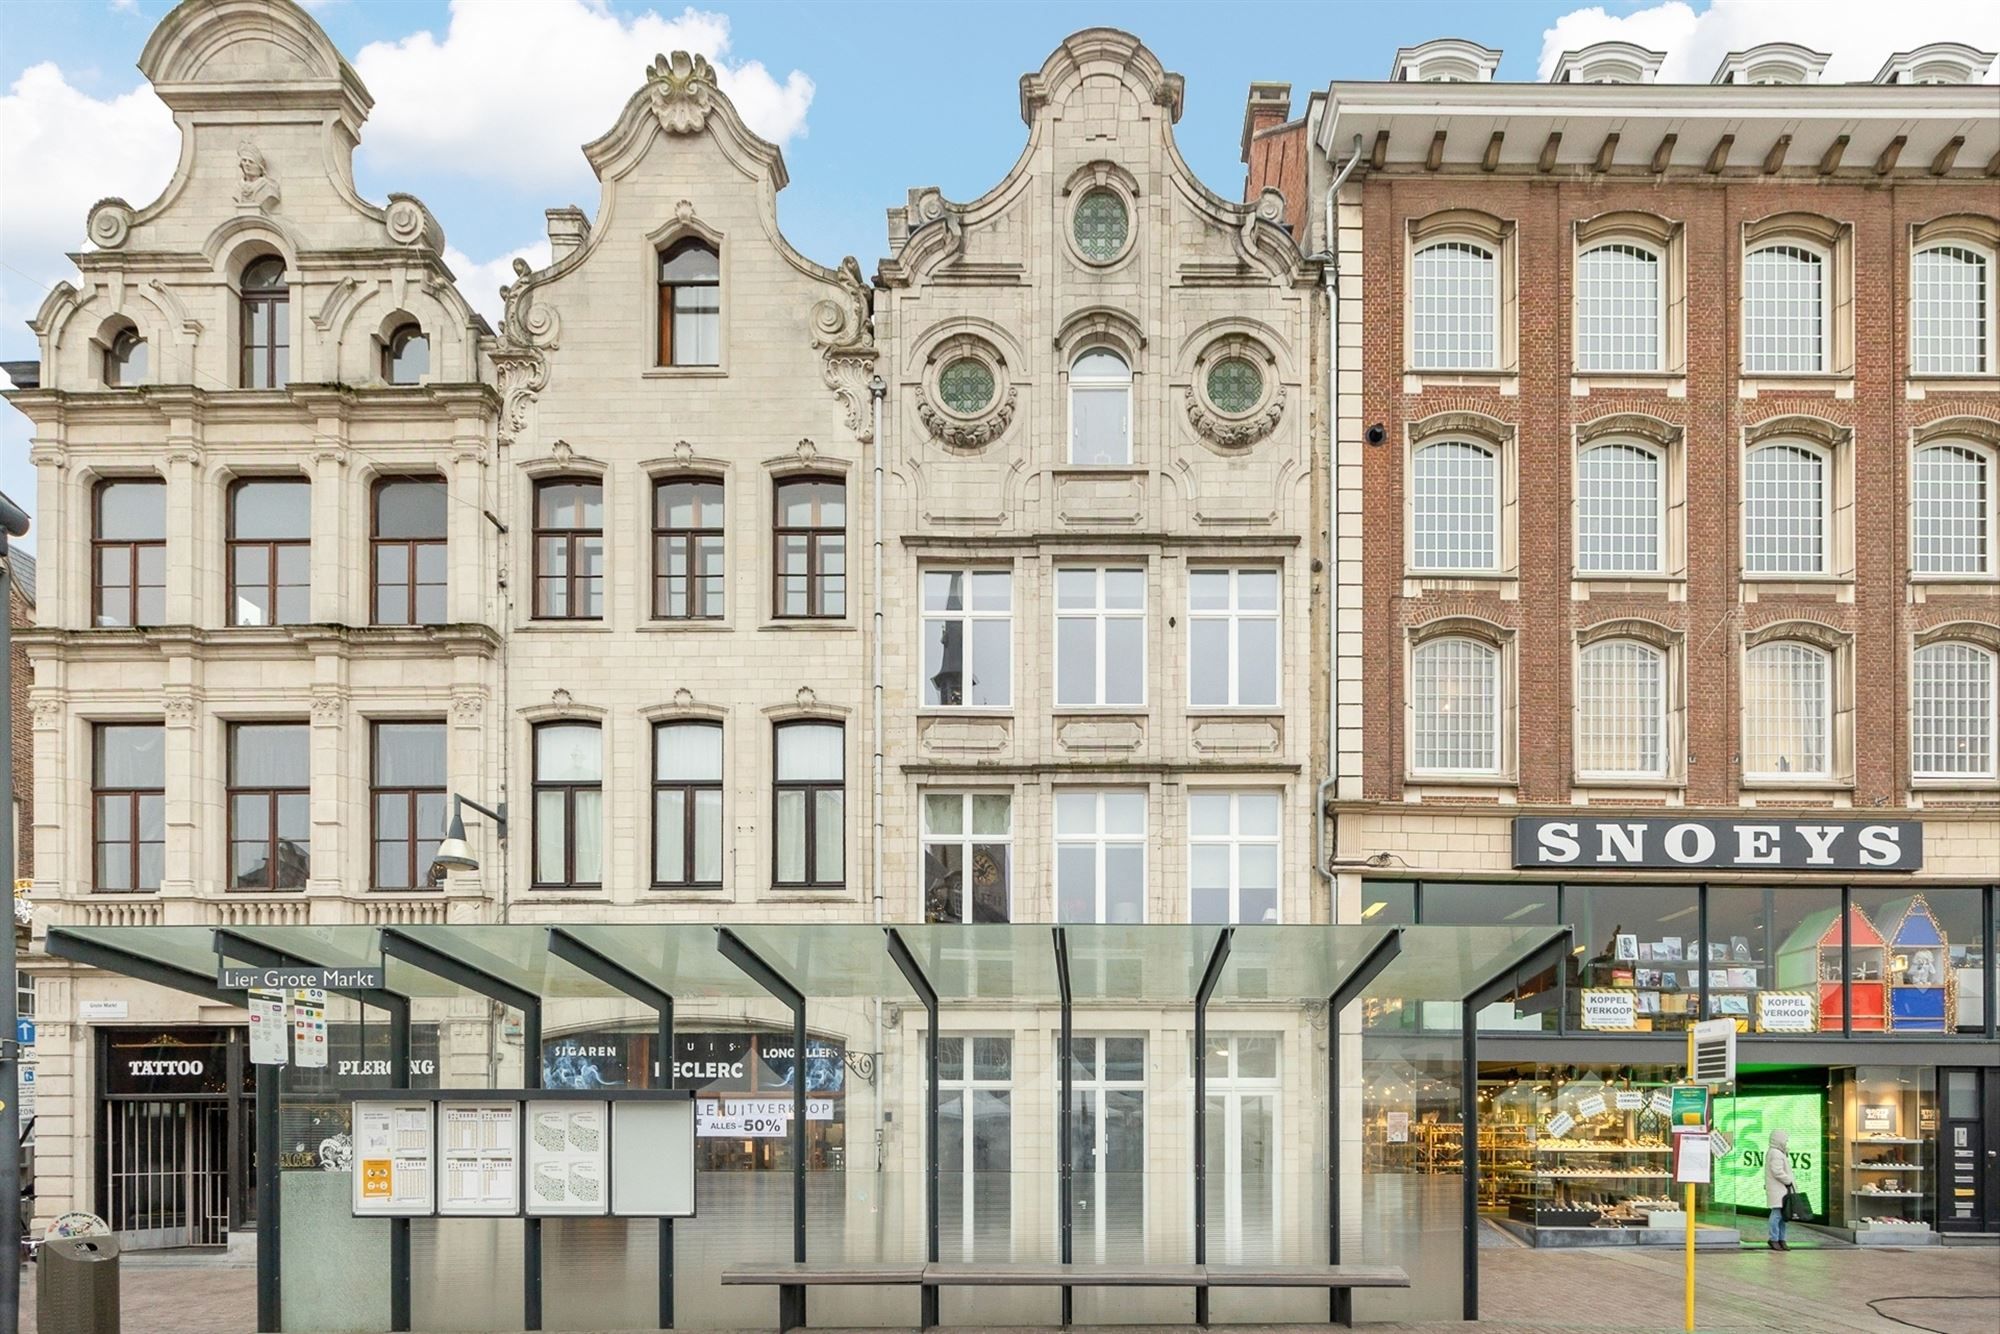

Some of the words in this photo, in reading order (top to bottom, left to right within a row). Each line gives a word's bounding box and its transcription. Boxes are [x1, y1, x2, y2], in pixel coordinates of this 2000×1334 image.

[1537, 822, 1902, 866] SNOEYS
[225, 970, 258, 987] Lier
[264, 970, 317, 987] Grote
[323, 970, 375, 987] Markt
[1590, 996, 1628, 1005] KOPPEL
[1768, 999, 1806, 1007] KOPPEL
[1586, 1007, 1632, 1015] VERKOOP
[1764, 1009, 1810, 1017] VERKOOP
[555, 1046, 617, 1057] SIGAREN
[763, 1047, 838, 1059] LONGLLER
[128, 1060, 203, 1076] TATTOO
[338, 1060, 435, 1076] PIERNG
[727, 1103, 830, 1117] UITVERKOP
[710, 1122, 737, 1130] ALLES
[1743, 1150, 1812, 1170] SNYS
